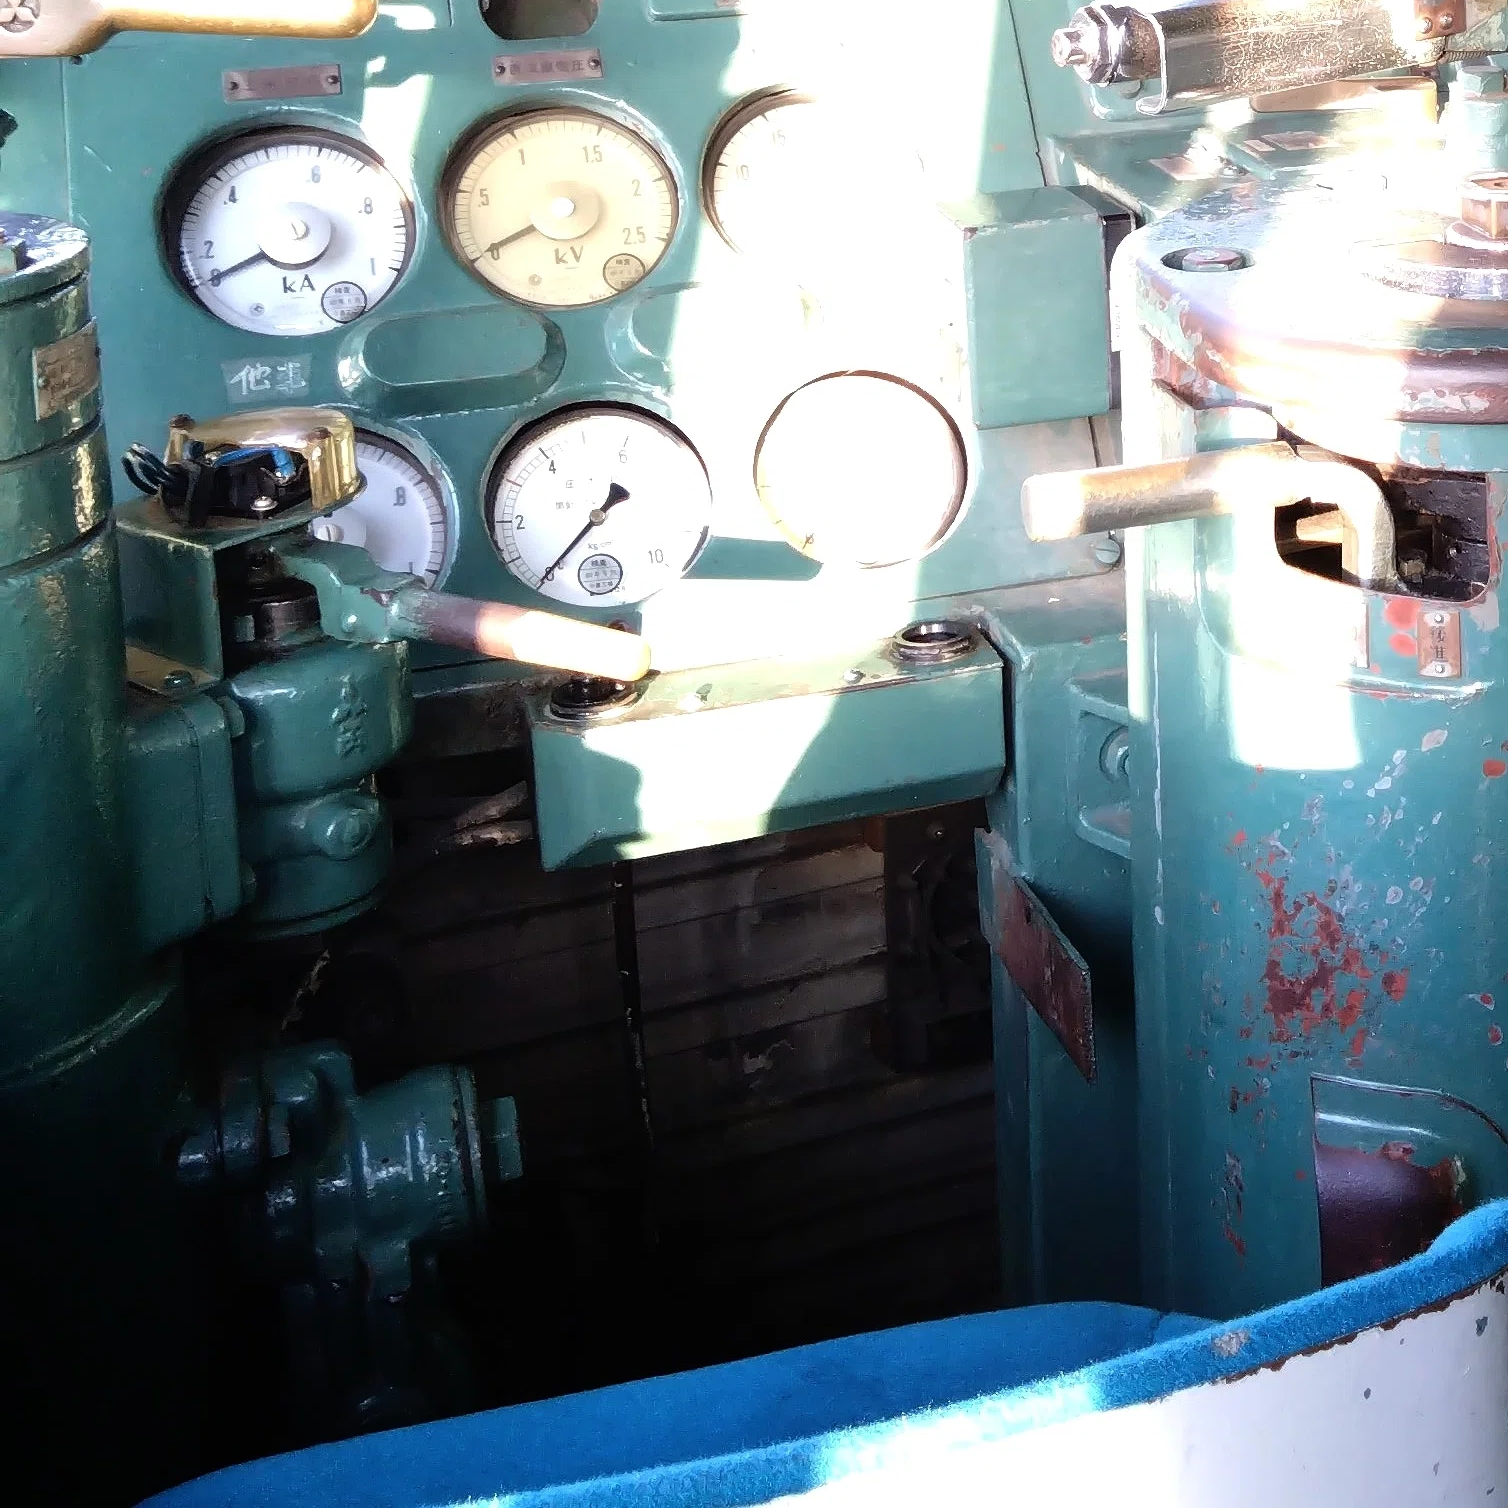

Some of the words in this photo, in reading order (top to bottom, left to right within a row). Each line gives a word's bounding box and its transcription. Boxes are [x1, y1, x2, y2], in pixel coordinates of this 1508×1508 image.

[518, 148, 526, 165] 1
[582, 145, 603, 163] 1.5
[632, 179, 642, 197] 2
[622, 226, 646, 245] 2.5
[554, 245, 584, 265] kV
[282, 274, 316, 294] kA
[619, 449, 628, 463] 6
[548, 459, 556, 474] 4
[515, 514, 526, 530] 2
[648, 548, 664, 564] 10
